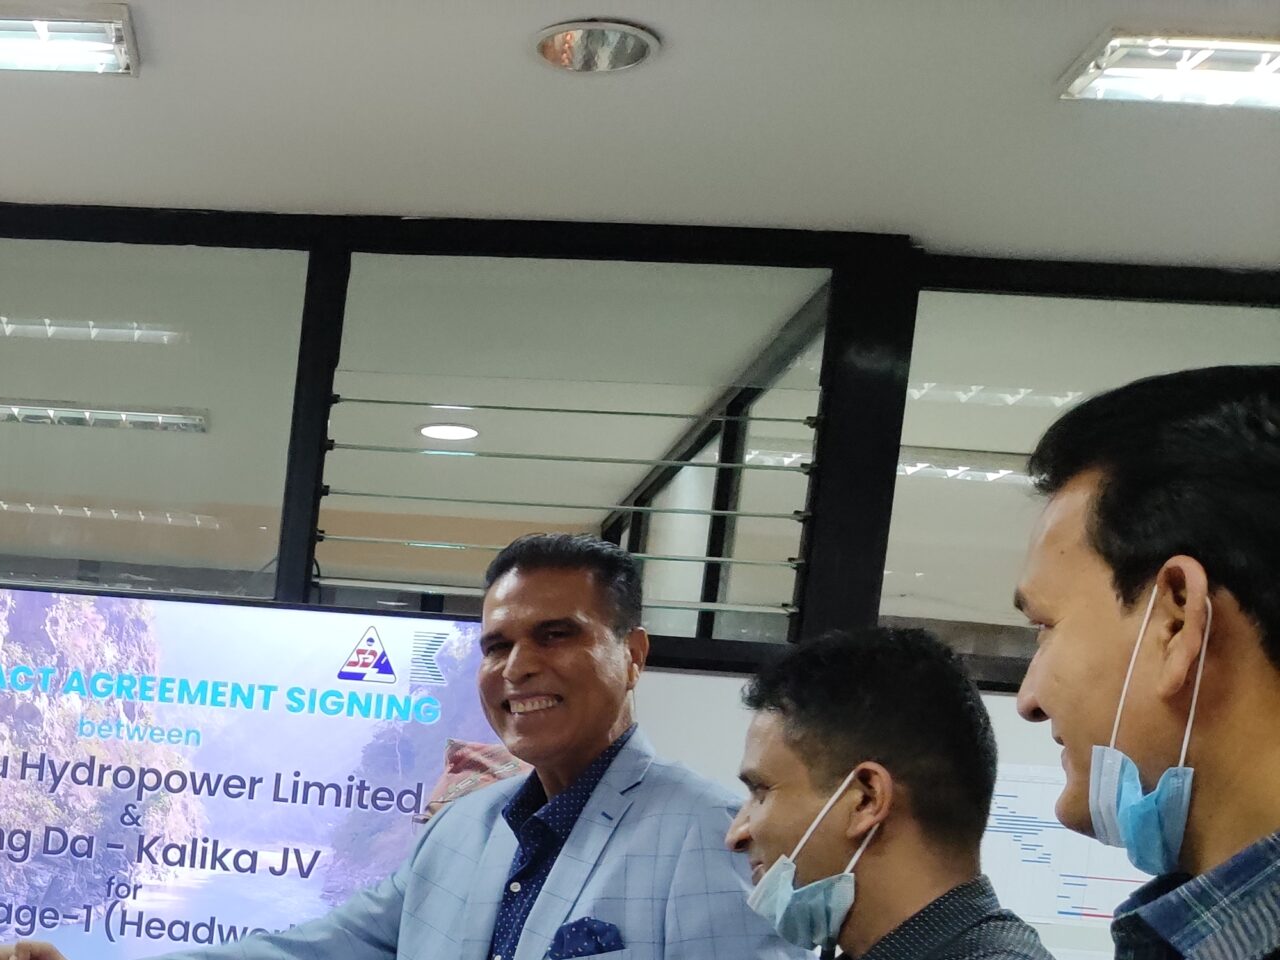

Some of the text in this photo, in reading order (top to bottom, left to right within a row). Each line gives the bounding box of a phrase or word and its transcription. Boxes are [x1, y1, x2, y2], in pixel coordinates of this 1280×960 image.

[63, 670, 278, 711] AGREEMENT
[286, 685, 441, 724] SIGNING
[78, 715, 201, 747] between
[20, 751, 264, 801] Hydropower
[273, 770, 424, 814] Limited
[120, 803, 142, 827] &
[42, 825, 95, 859] Da
[136, 835, 258, 874] Kalika
[269, 847, 322, 879] JV
[106, 876, 142, 900] for
